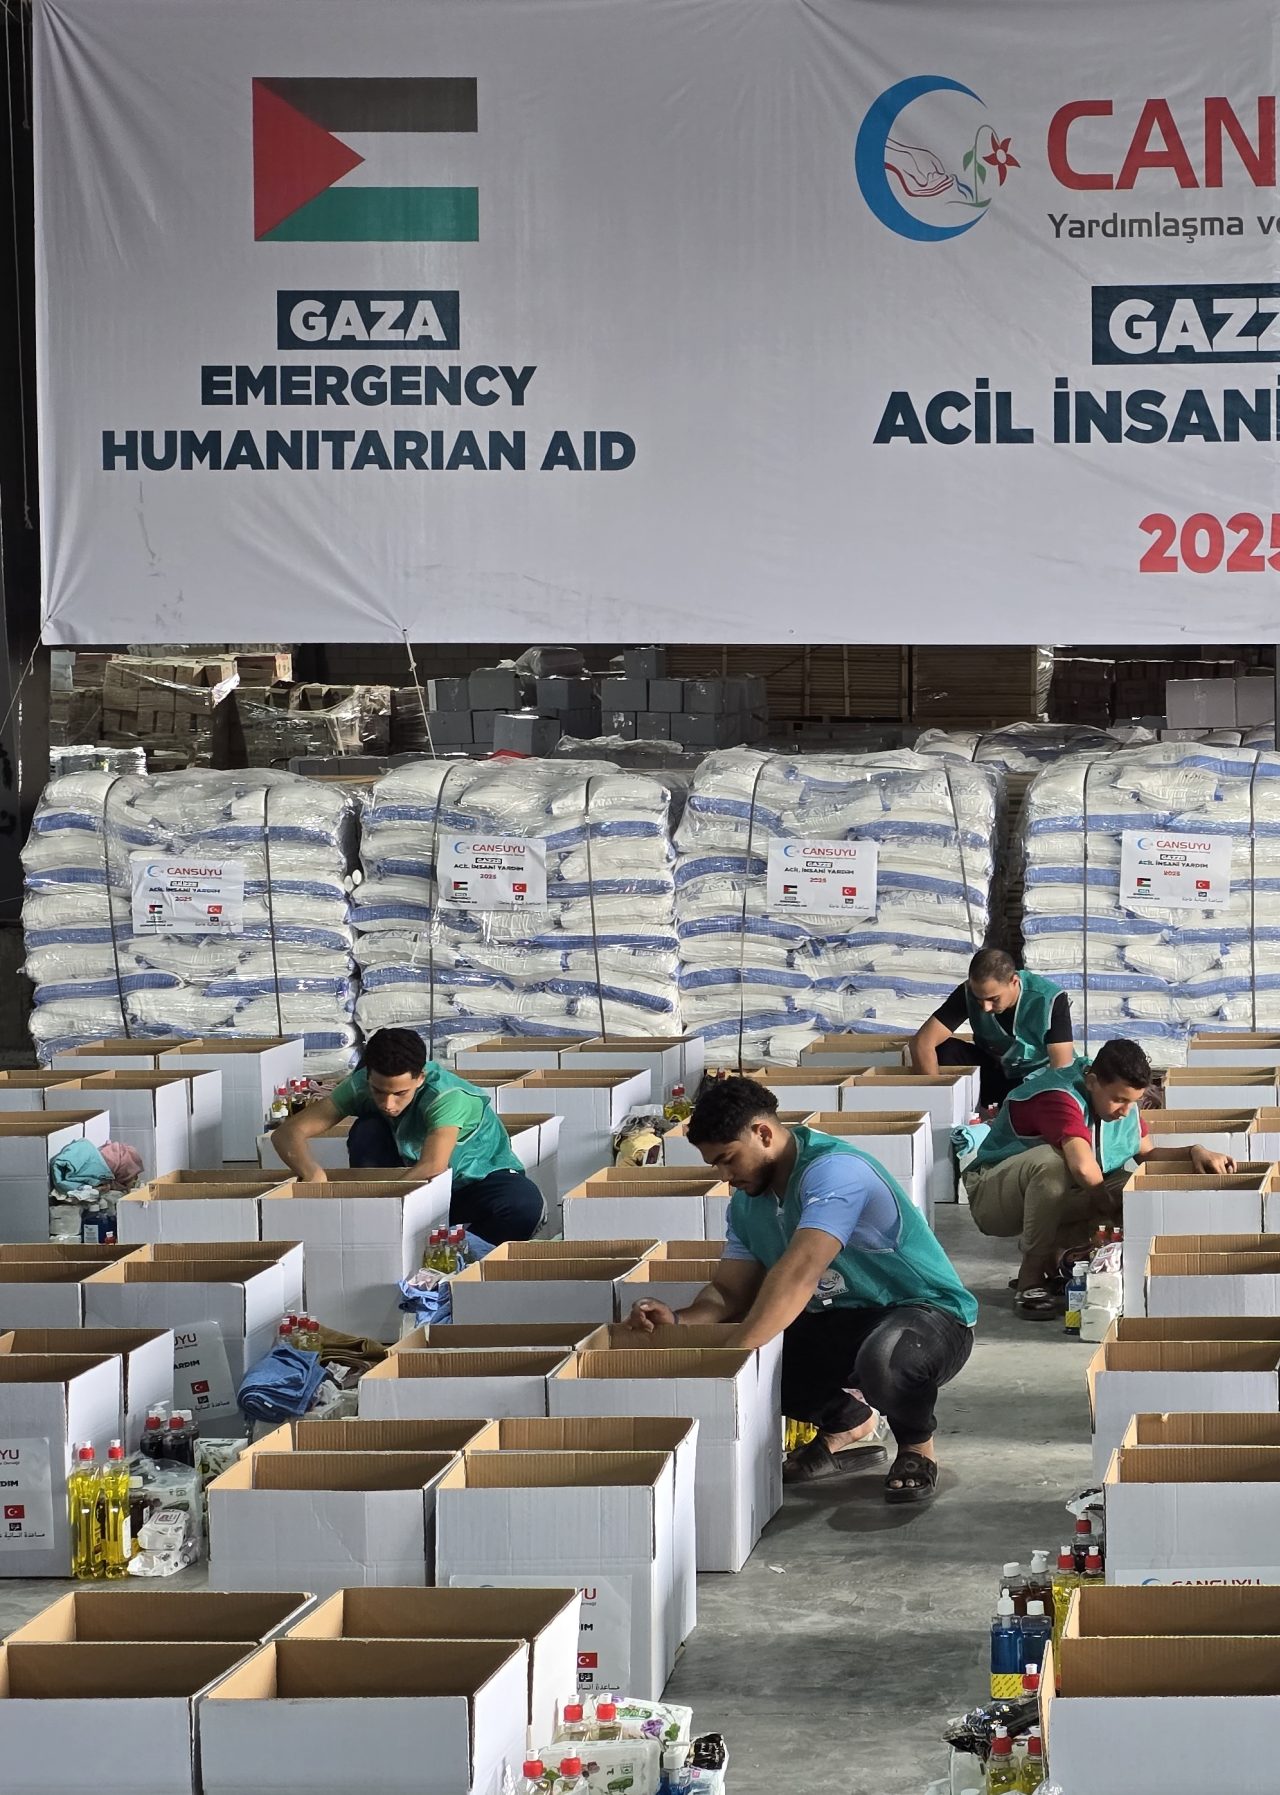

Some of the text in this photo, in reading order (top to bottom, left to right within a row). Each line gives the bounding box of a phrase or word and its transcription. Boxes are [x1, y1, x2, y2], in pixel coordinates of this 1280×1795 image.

[1048, 211, 1244, 244] Yardımlaşma
[290, 300, 446, 342] GAZA
[202, 365, 537, 407] EMERGENCY
[873, 378, 1034, 445] ACİL
[103, 430, 636, 472] HUMANITARIAN AID
[472, 844, 525, 854] CANSUYU
[802, 847, 857, 857] CANSUYU
[1156, 840, 1211, 850] CANSUYU
[167, 867, 222, 876] CANSUYU
[174, 1360, 200, 1370] ARDIM
